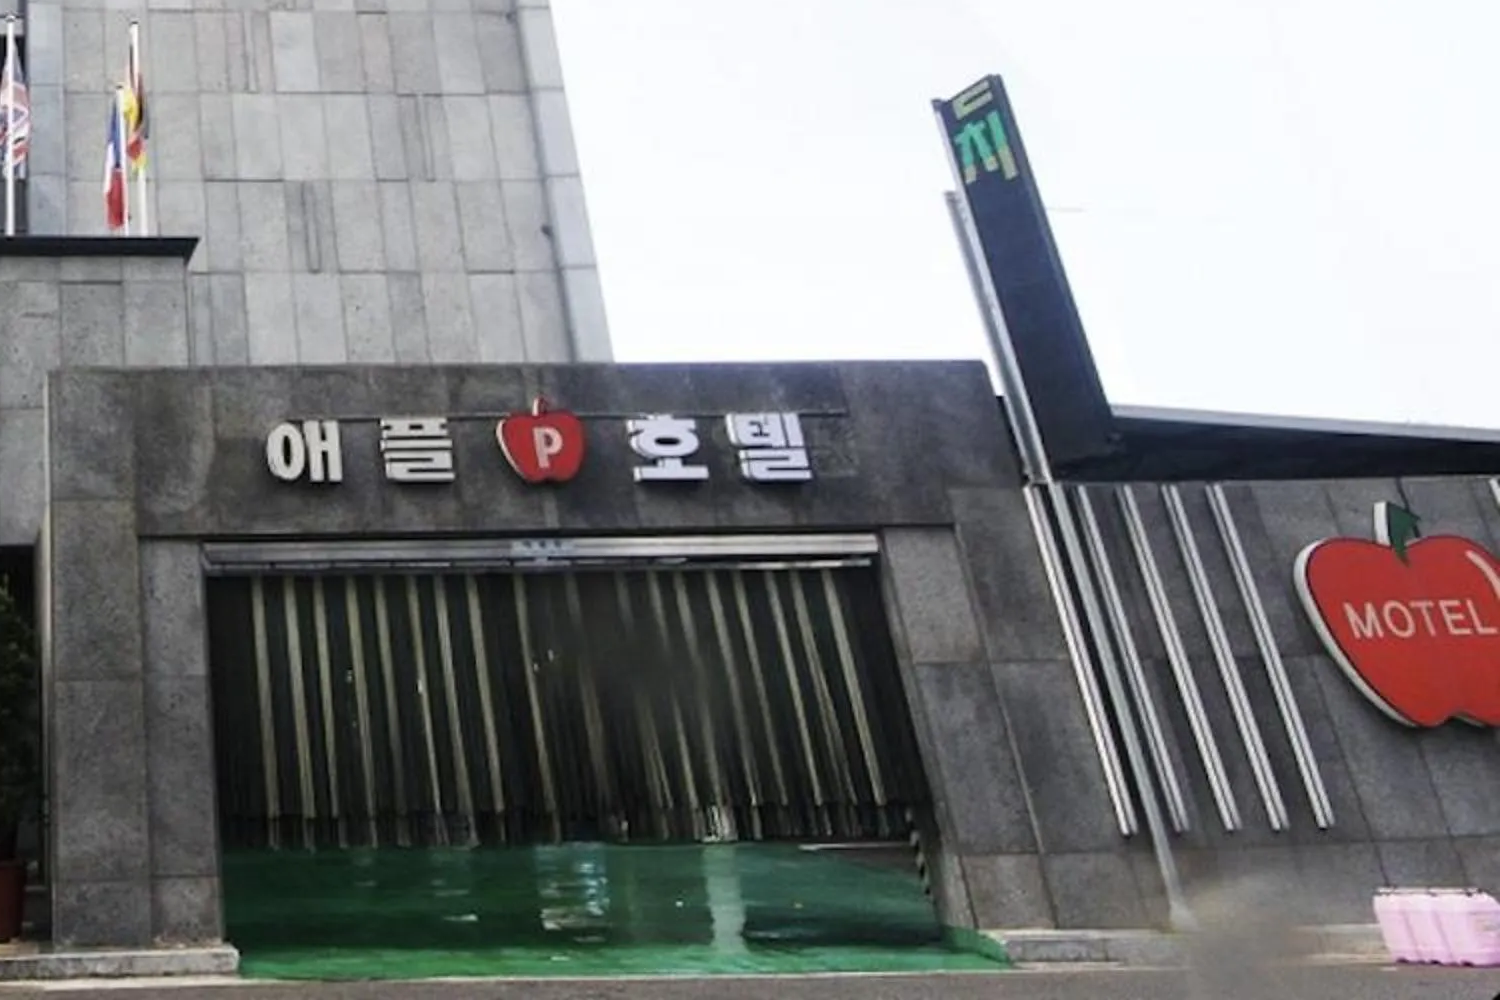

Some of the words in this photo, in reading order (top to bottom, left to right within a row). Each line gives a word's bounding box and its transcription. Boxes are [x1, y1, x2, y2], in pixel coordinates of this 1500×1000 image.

[266, 415, 455, 482] 애플
[533, 426, 564, 469] P
[626, 412, 813, 482] 호텔
[1342, 598, 1499, 640] MOTEL
